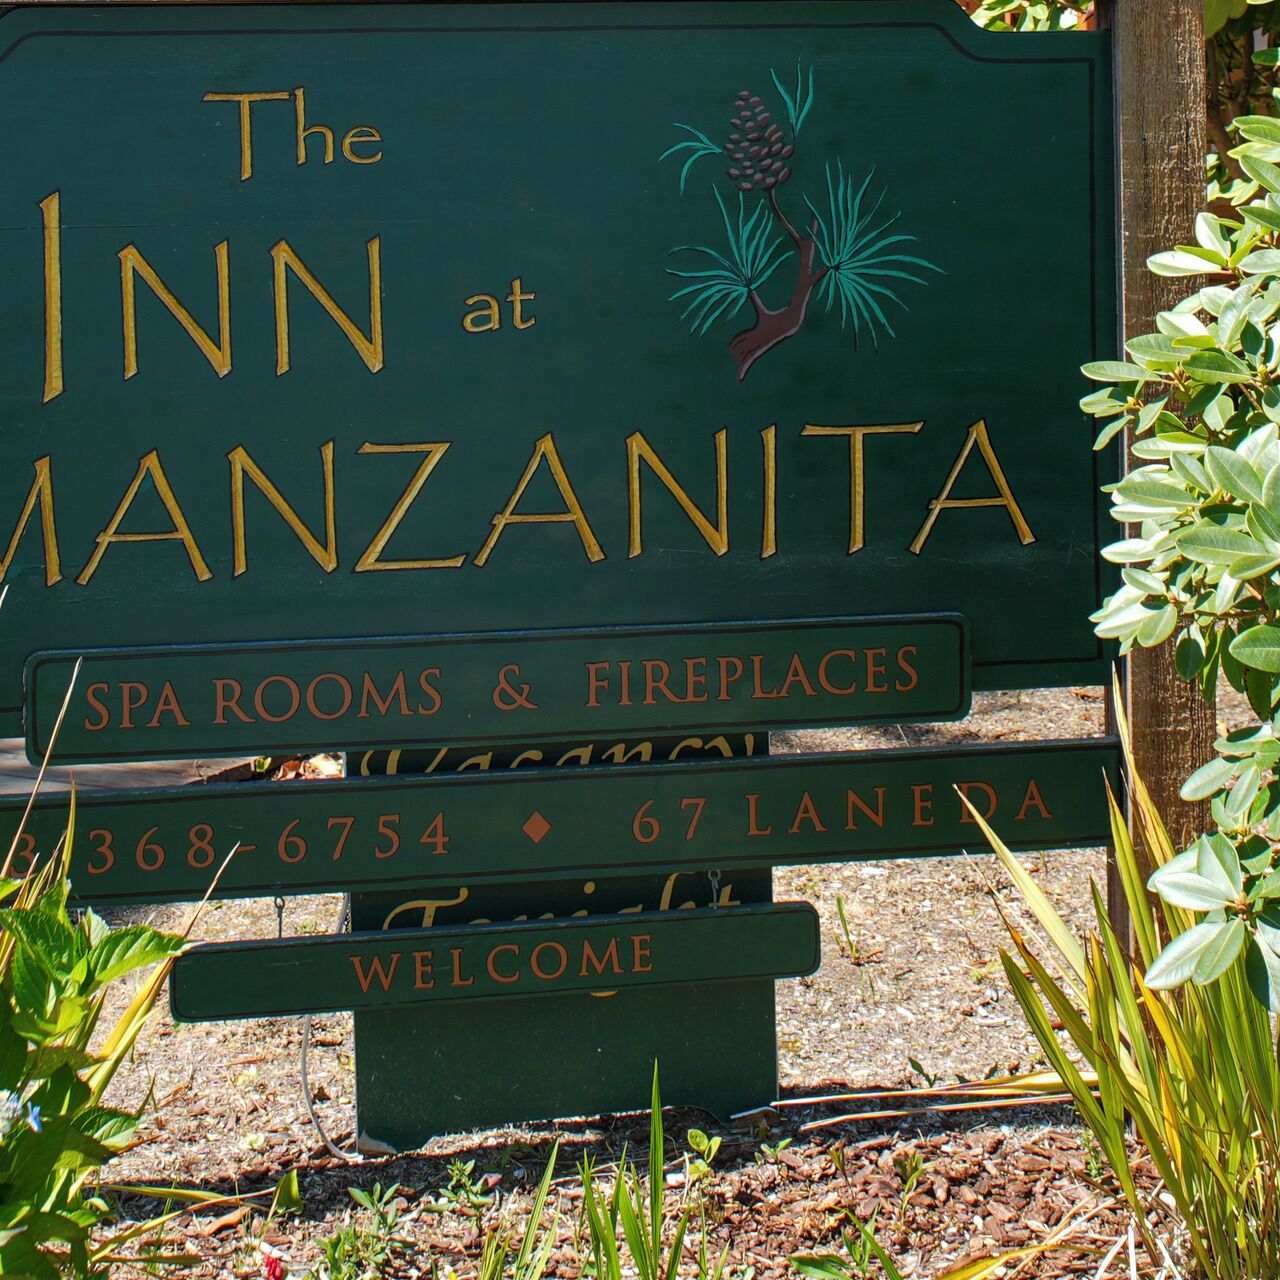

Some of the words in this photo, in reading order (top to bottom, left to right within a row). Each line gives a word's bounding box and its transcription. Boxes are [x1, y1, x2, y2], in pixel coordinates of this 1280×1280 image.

[203, 86, 383, 180] The
[39, 190, 385, 404] INN
[461, 278, 536, 333] at
[84, 681, 190, 732] SPA
[213, 667, 443, 725] ROOMS
[492, 663, 537, 711] &
[586, 644, 920, 708] FIREPLACES
[86, 811, 450, 876] 368-6754
[631, 796, 707, 845] 67
[745, 779, 1053, 838] LANEDA
[349, 933, 655, 993] WELCOME
